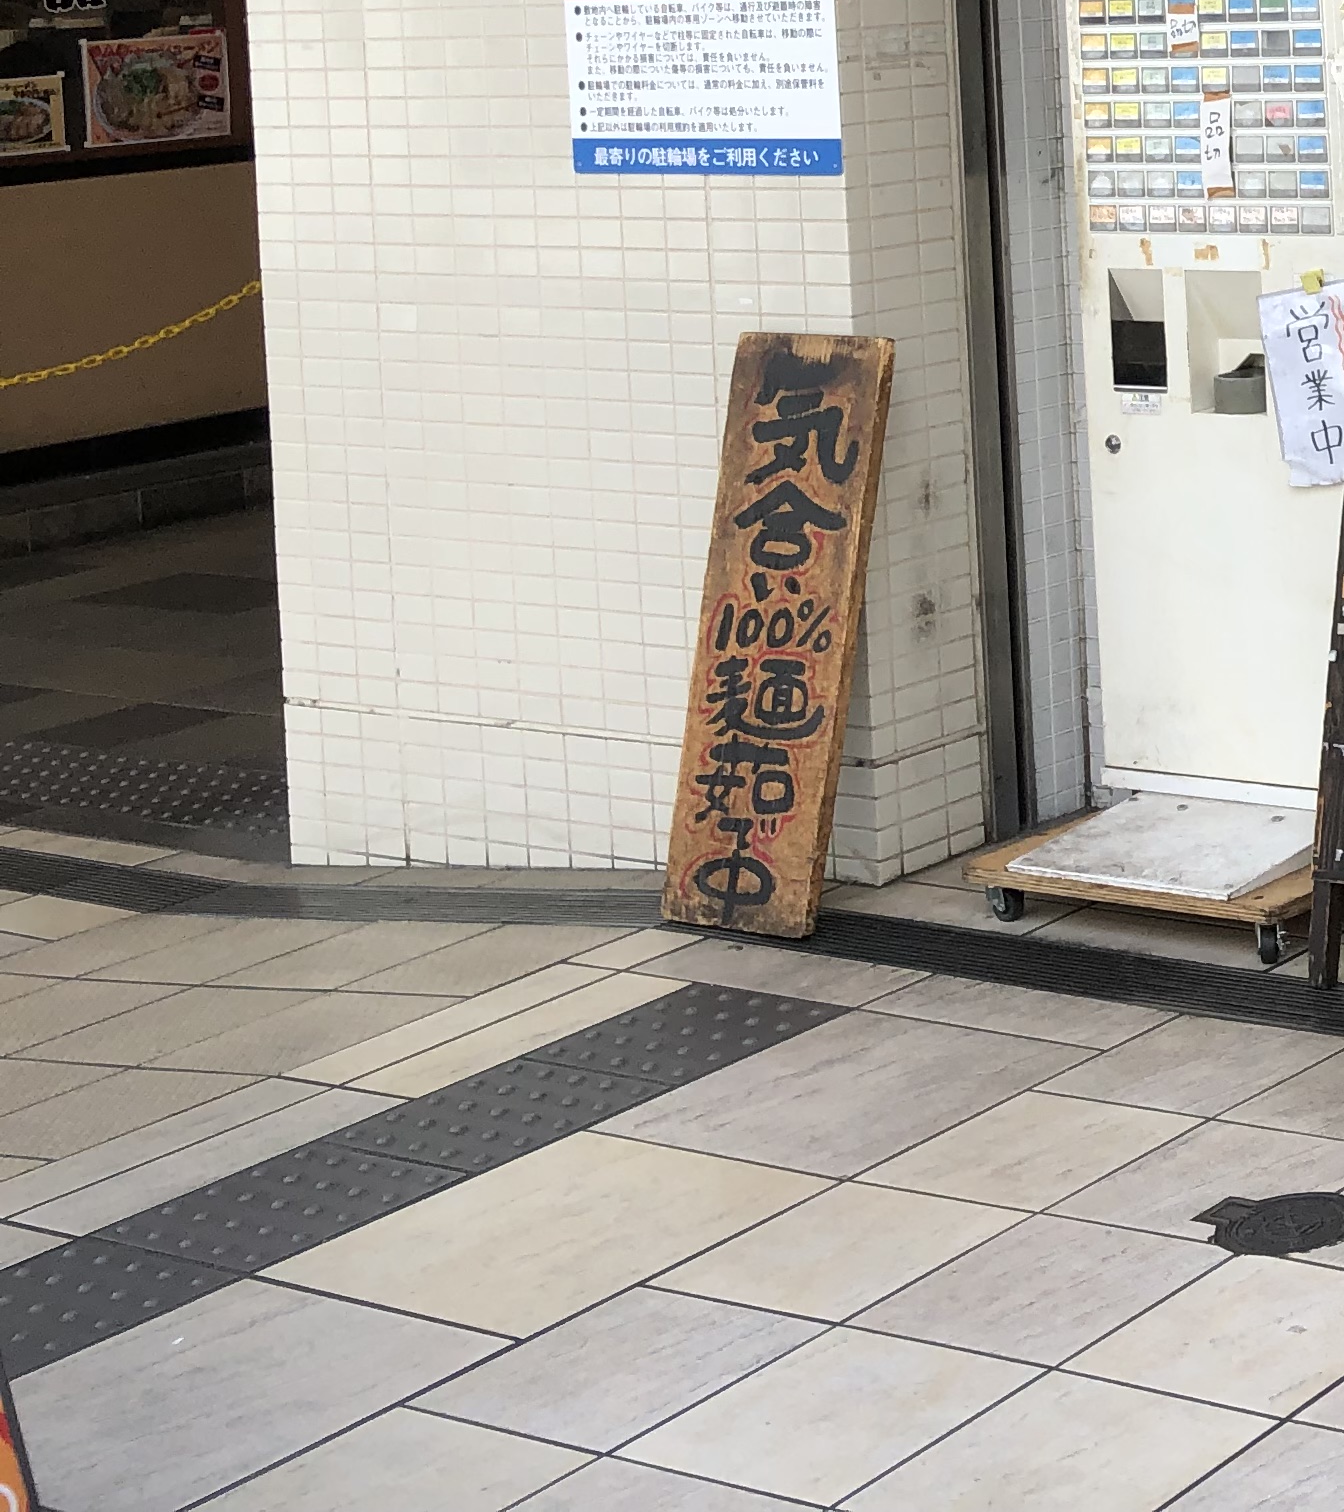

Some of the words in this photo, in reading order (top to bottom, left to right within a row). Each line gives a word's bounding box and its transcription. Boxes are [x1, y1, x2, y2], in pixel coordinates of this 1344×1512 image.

[594, 146, 819, 167] 最寄りの駐輪場をご利用ください
[1286, 301, 1343, 465] 営業中
